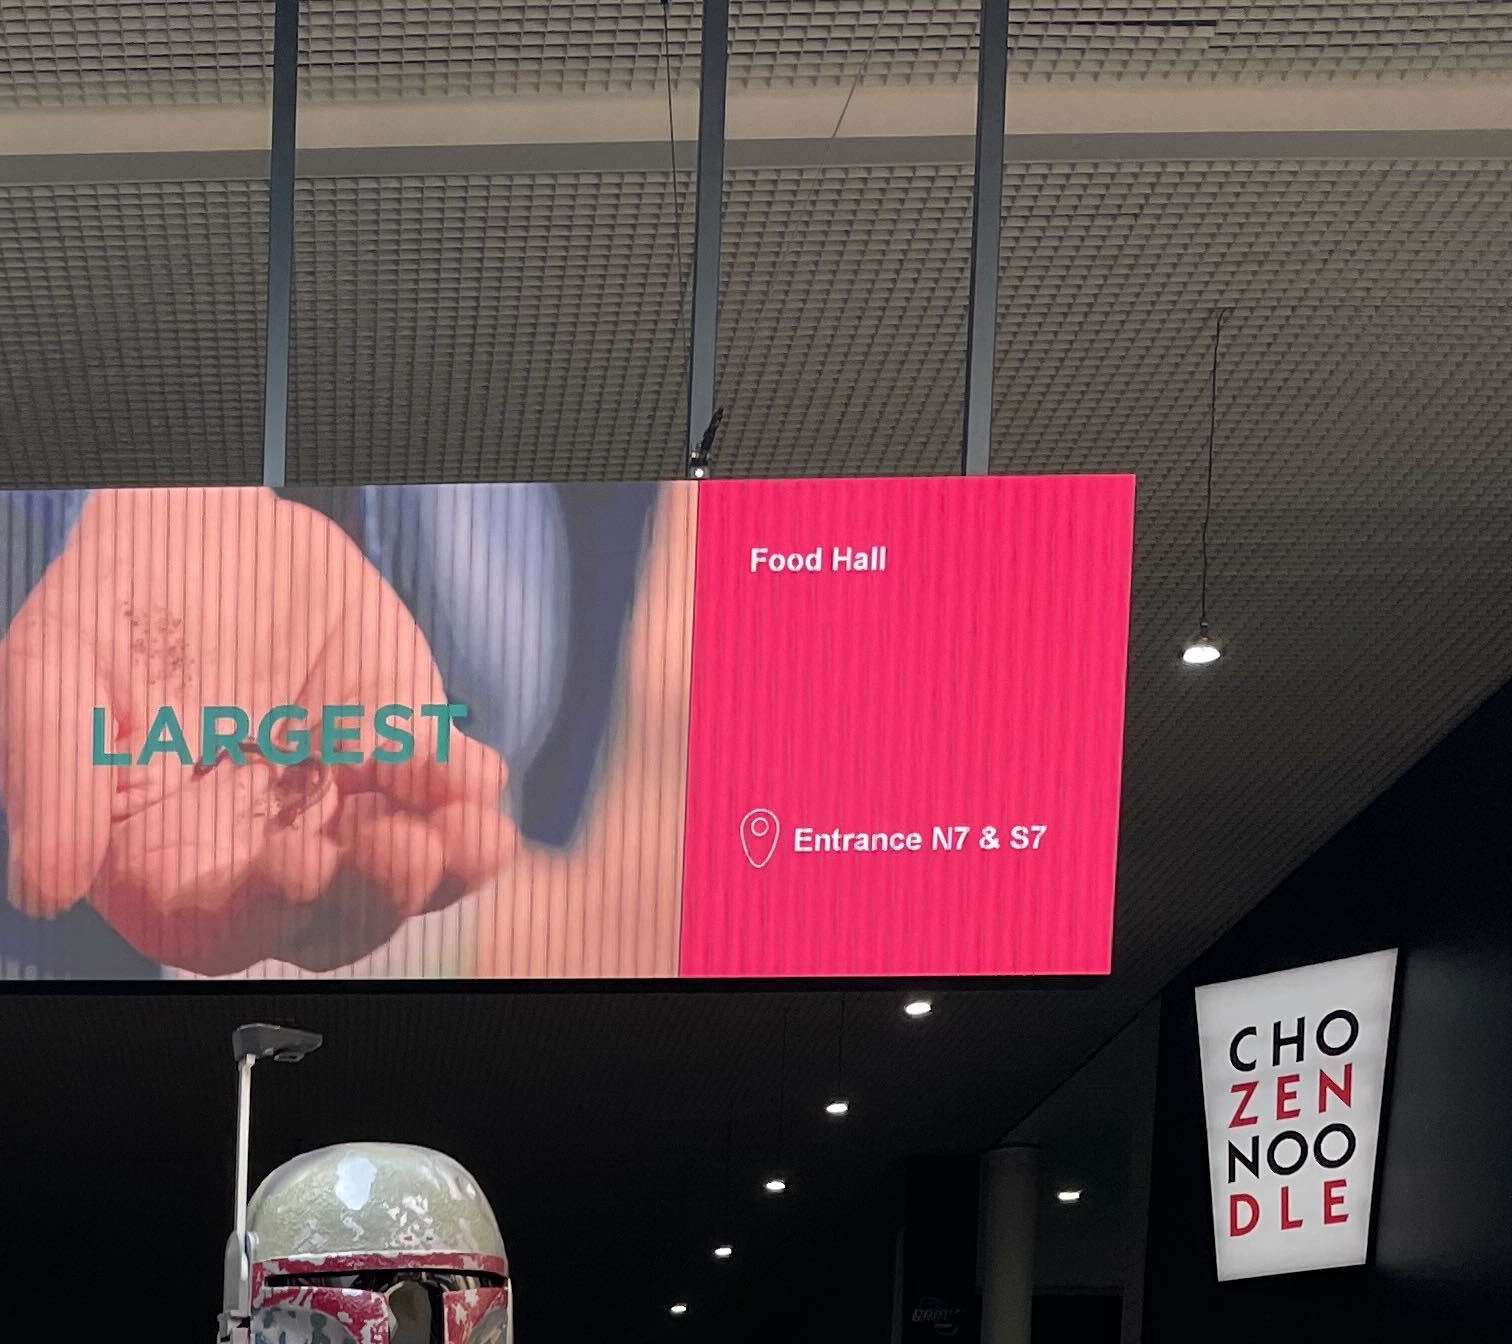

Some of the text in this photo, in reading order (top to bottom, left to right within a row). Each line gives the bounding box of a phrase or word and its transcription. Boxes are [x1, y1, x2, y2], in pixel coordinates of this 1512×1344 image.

[750, 546, 887, 572] Food Hall
[91, 702, 467, 766] LARGEST
[794, 825, 1048, 853] Entrance N7 & S7
[1228, 1008, 1360, 1073] CHO
[1228, 1063, 1354, 1129] ZEN
[1227, 1122, 1357, 1184] NOO
[1228, 1178, 1350, 1238] DLE
